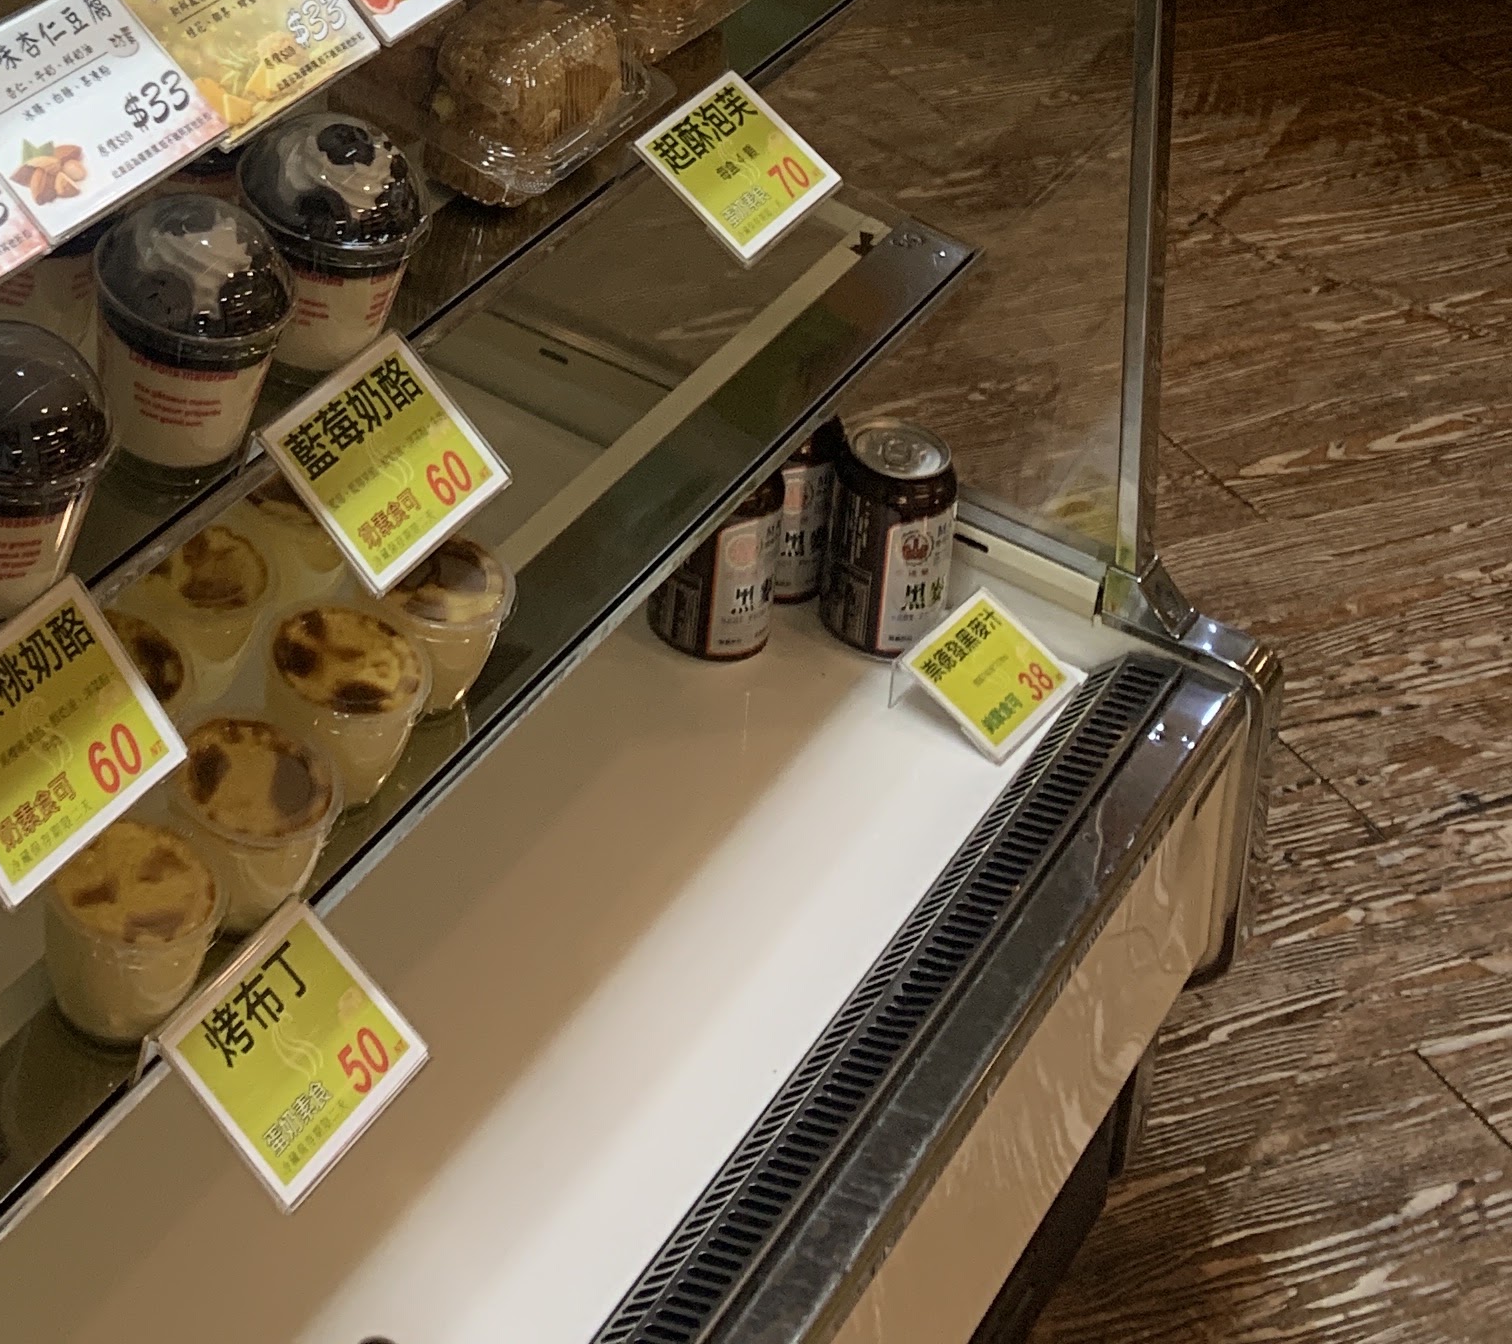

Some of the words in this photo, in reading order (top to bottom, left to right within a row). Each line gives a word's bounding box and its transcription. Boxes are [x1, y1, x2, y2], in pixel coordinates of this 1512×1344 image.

[113, 66, 201, 136] $33
[652, 86, 759, 176] 起酥泡芙
[766, 156, 811, 199] 70
[281, 354, 425, 483] 藍莓奶酪
[419, 446, 478, 509] 60
[354, 484, 423, 552] 奶素食可
[919, 607, 1003, 684] 崇德發黑麥汁
[1017, 662, 1055, 702] 38
[79, 718, 151, 799] 60
[200, 940, 308, 1069] 烤布丁
[331, 1022, 396, 1098] 50
[260, 1075, 334, 1159] 蛋奶素食
